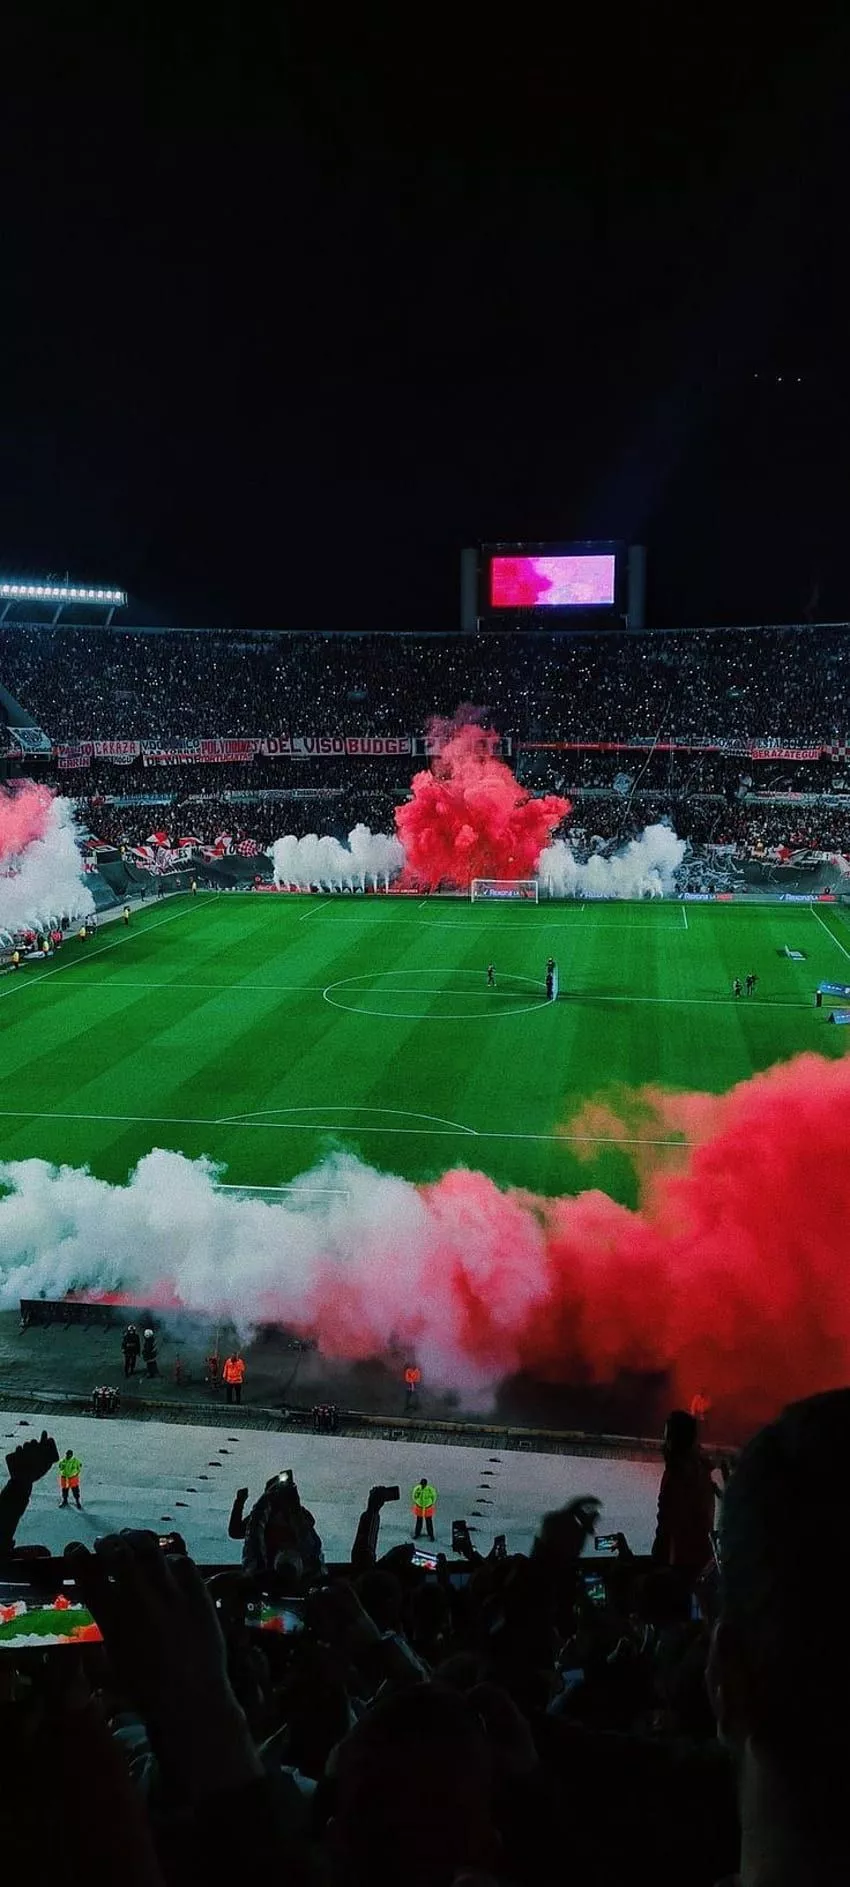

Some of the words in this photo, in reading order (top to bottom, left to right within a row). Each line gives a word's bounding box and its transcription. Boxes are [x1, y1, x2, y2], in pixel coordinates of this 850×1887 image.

[267, 738, 305, 753] DEL
[304, 738, 345, 753] VISO
[349, 739, 408, 753] BUDGE
[752, 749, 818, 760] BERAZATEGUI
